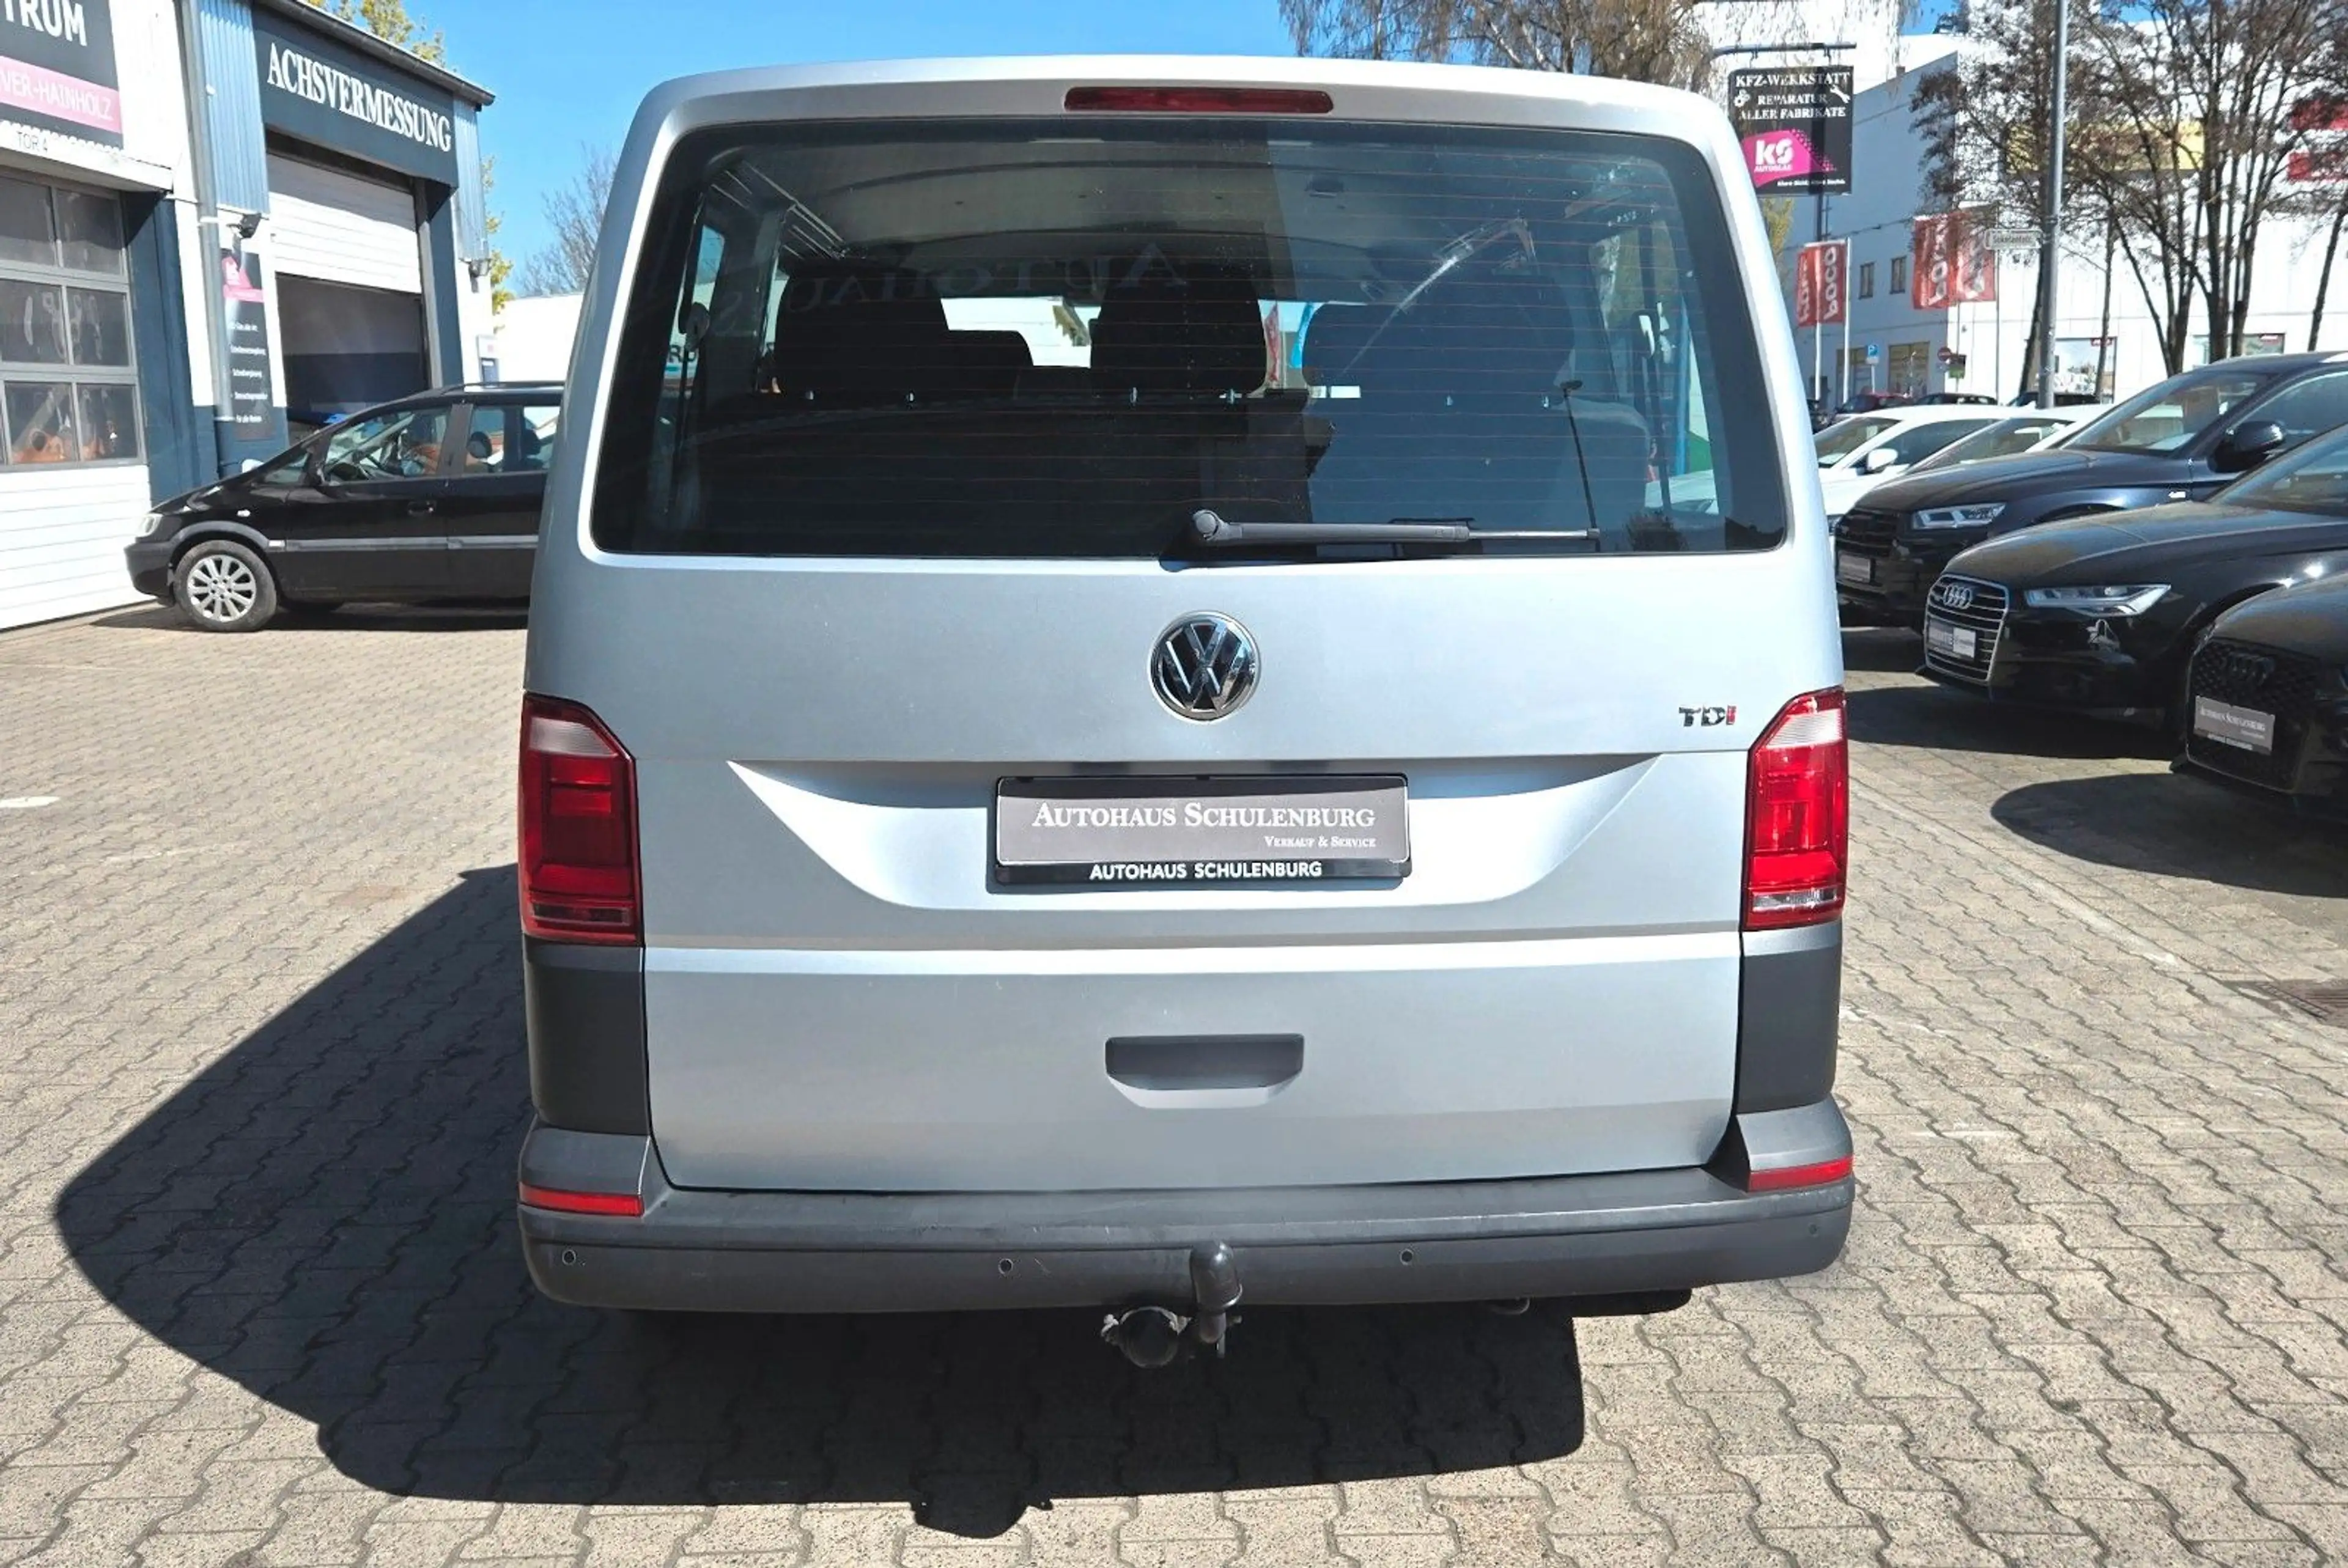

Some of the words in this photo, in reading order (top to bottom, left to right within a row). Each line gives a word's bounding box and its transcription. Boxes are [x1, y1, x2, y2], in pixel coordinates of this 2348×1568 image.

[1735, 72, 1850, 87] KFZ-WERKSTATT
[267, 42, 451, 152] ACHSVERMESSUNG
[1757, 93, 1828, 106] REPARATUR
[1738, 109, 1778, 120] ALLER
[1780, 106, 1847, 119] FABRIKATE
[17, 130, 40, 151] TOR
[1318, 836, 1328, 847] &
[1089, 864, 1187, 880] AUTOHAUS
[1194, 861, 1323, 879] SCHULENBURG
